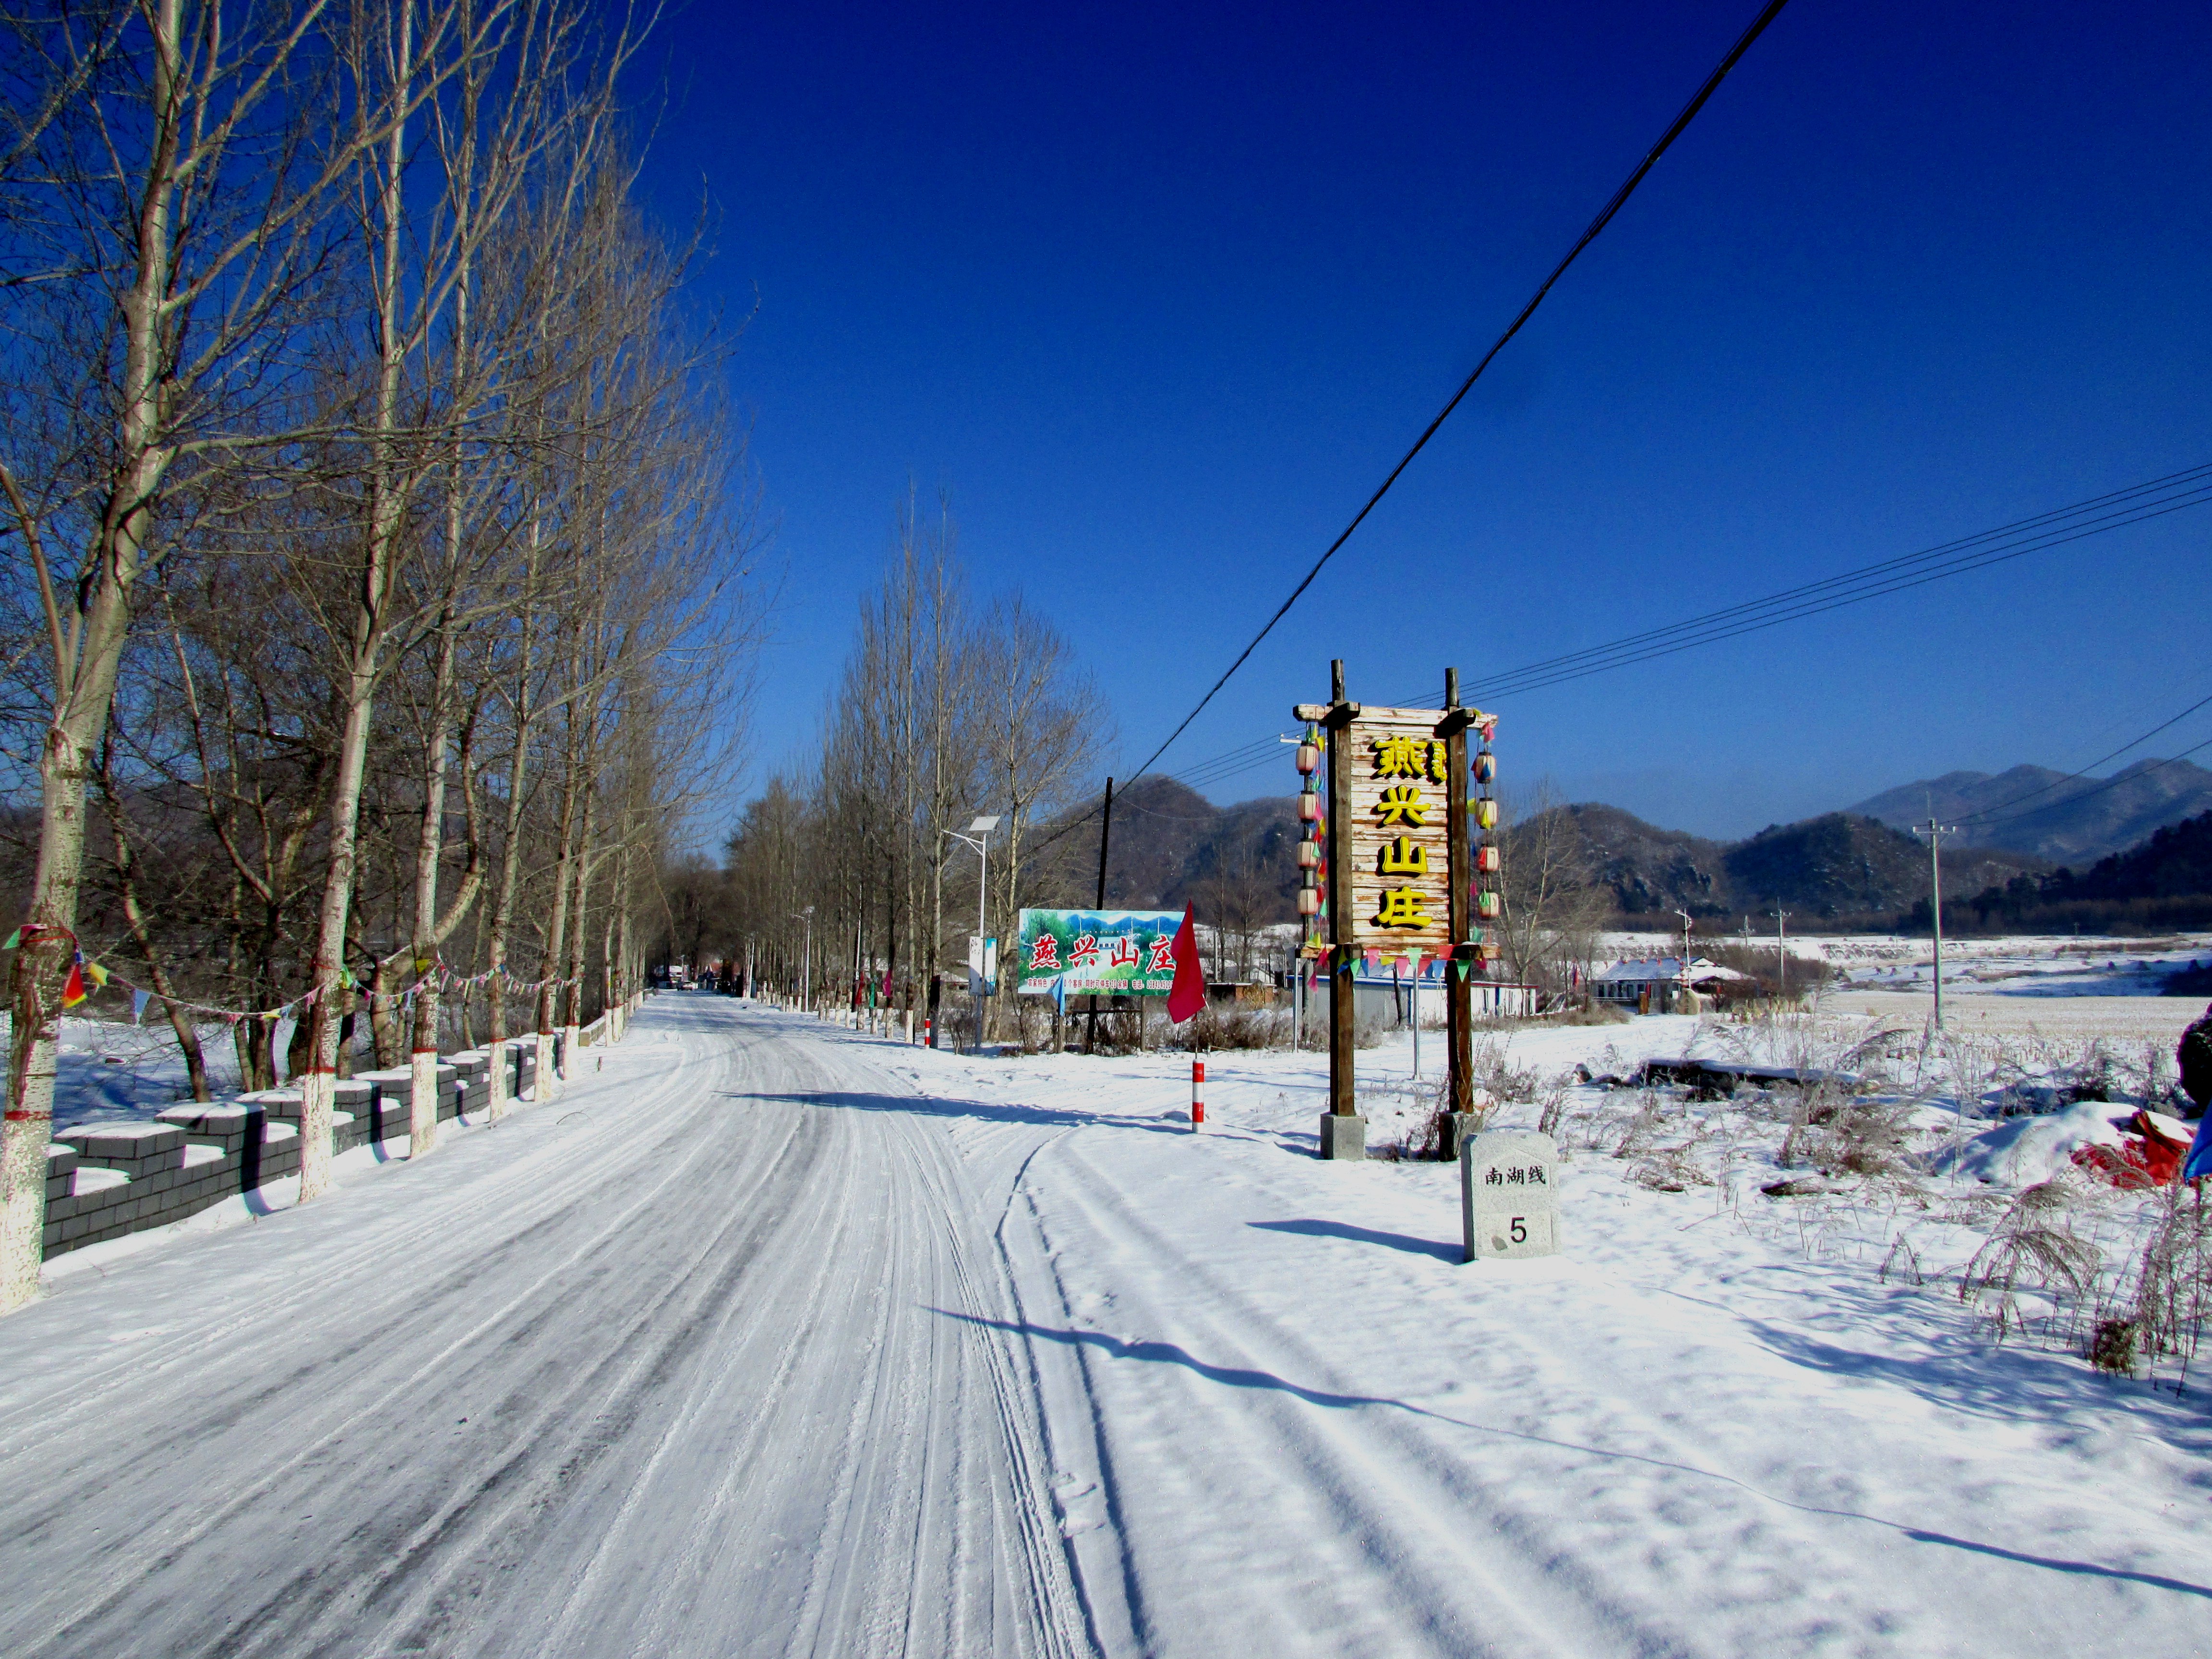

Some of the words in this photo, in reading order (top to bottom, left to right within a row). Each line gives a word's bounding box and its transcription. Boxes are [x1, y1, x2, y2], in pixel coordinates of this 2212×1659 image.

[1375, 736, 1432, 927] 燕兴山庄
[1029, 934, 1176, 974] 燕兴山庄
[1485, 1166, 1546, 1186] 南湖线
[1511, 1217, 1527, 1243] 5
